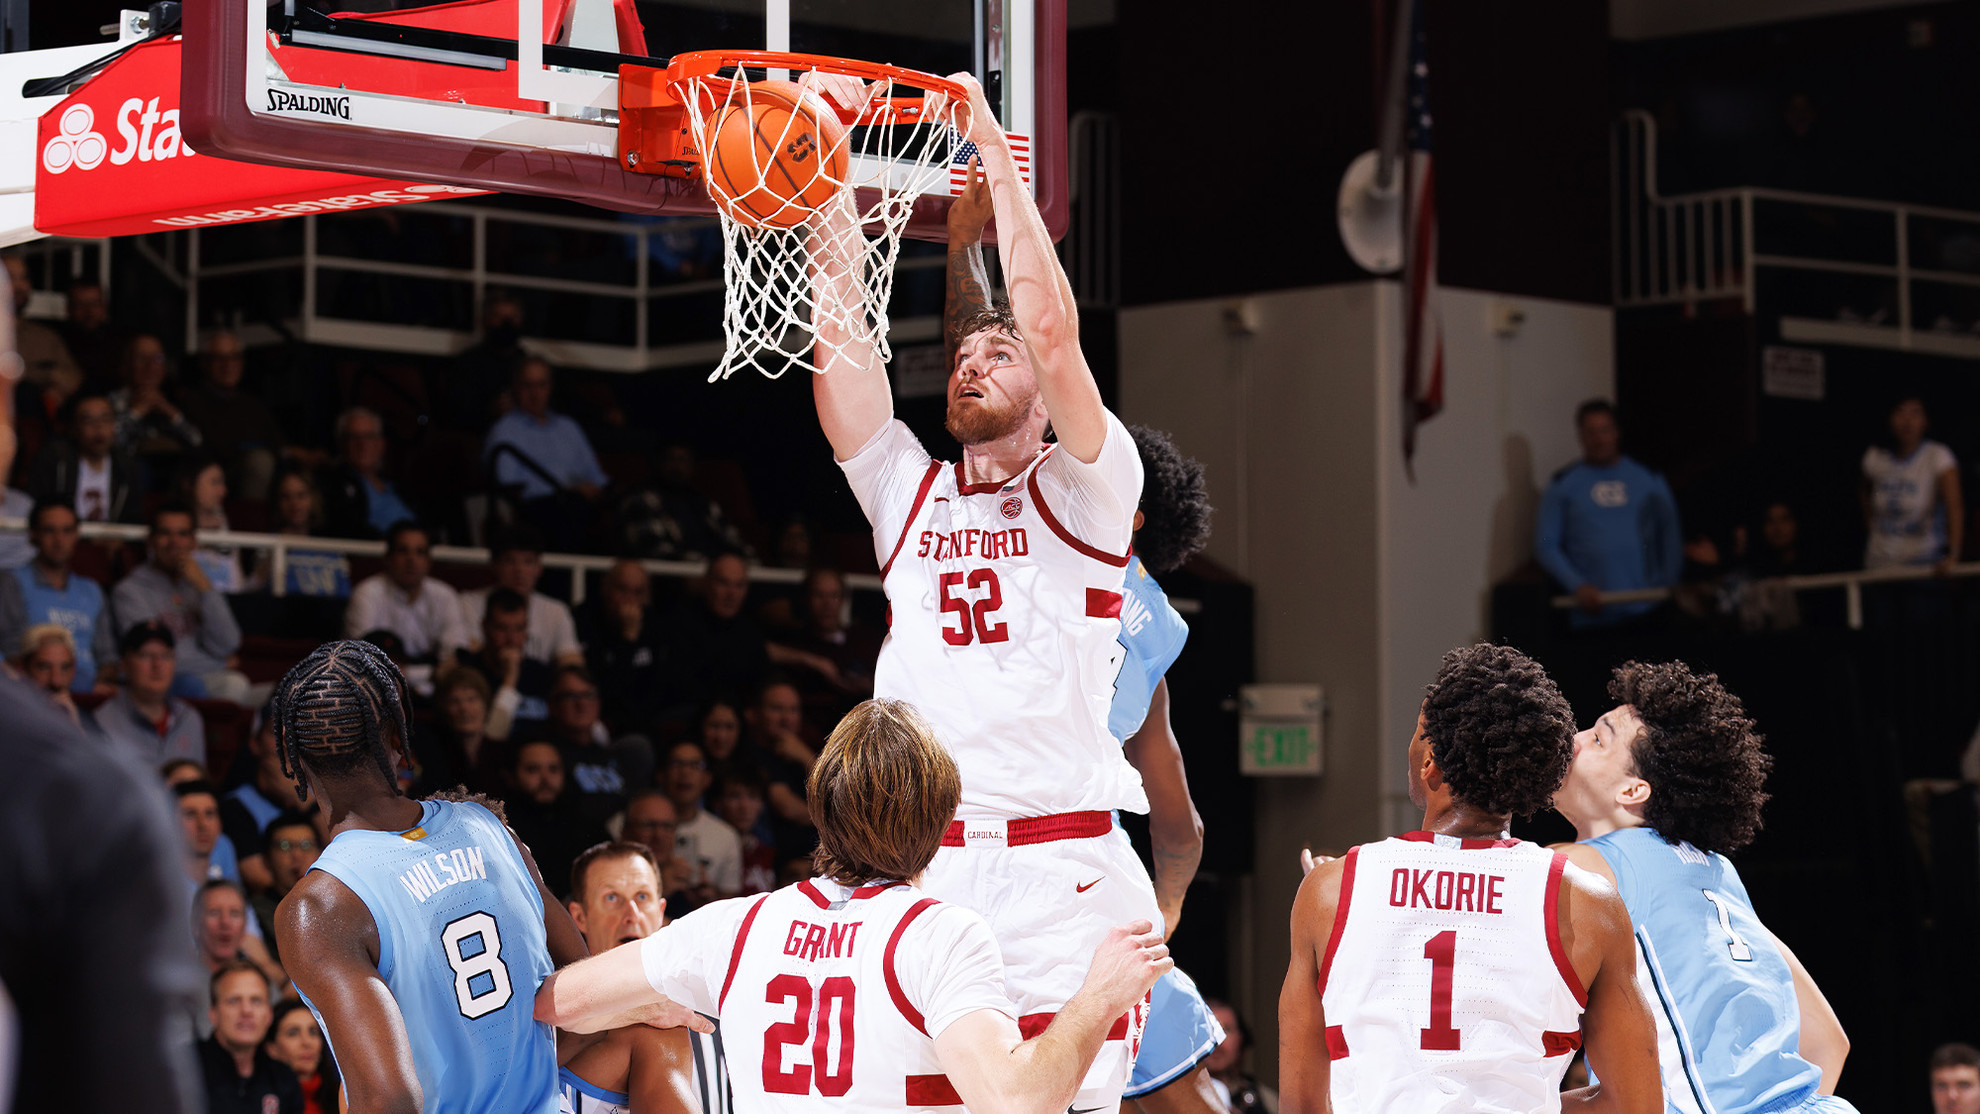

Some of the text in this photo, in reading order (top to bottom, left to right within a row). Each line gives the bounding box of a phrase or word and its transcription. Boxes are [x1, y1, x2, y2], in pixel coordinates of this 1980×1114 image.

[110, 96, 196, 165] Sta
[267, 88, 350, 120] SPALDING
[918, 528, 1029, 563] STNFORD
[939, 568, 1009, 646] 52
[967, 831, 1003, 839] CARDINAL
[400, 846, 487, 904] WILSON
[1389, 868, 1505, 914] OKORIE
[1701, 888, 1752, 961] 1
[441, 910, 514, 1020] 8
[1420, 930, 1461, 1050] 1
[762, 973, 856, 1097] 20
